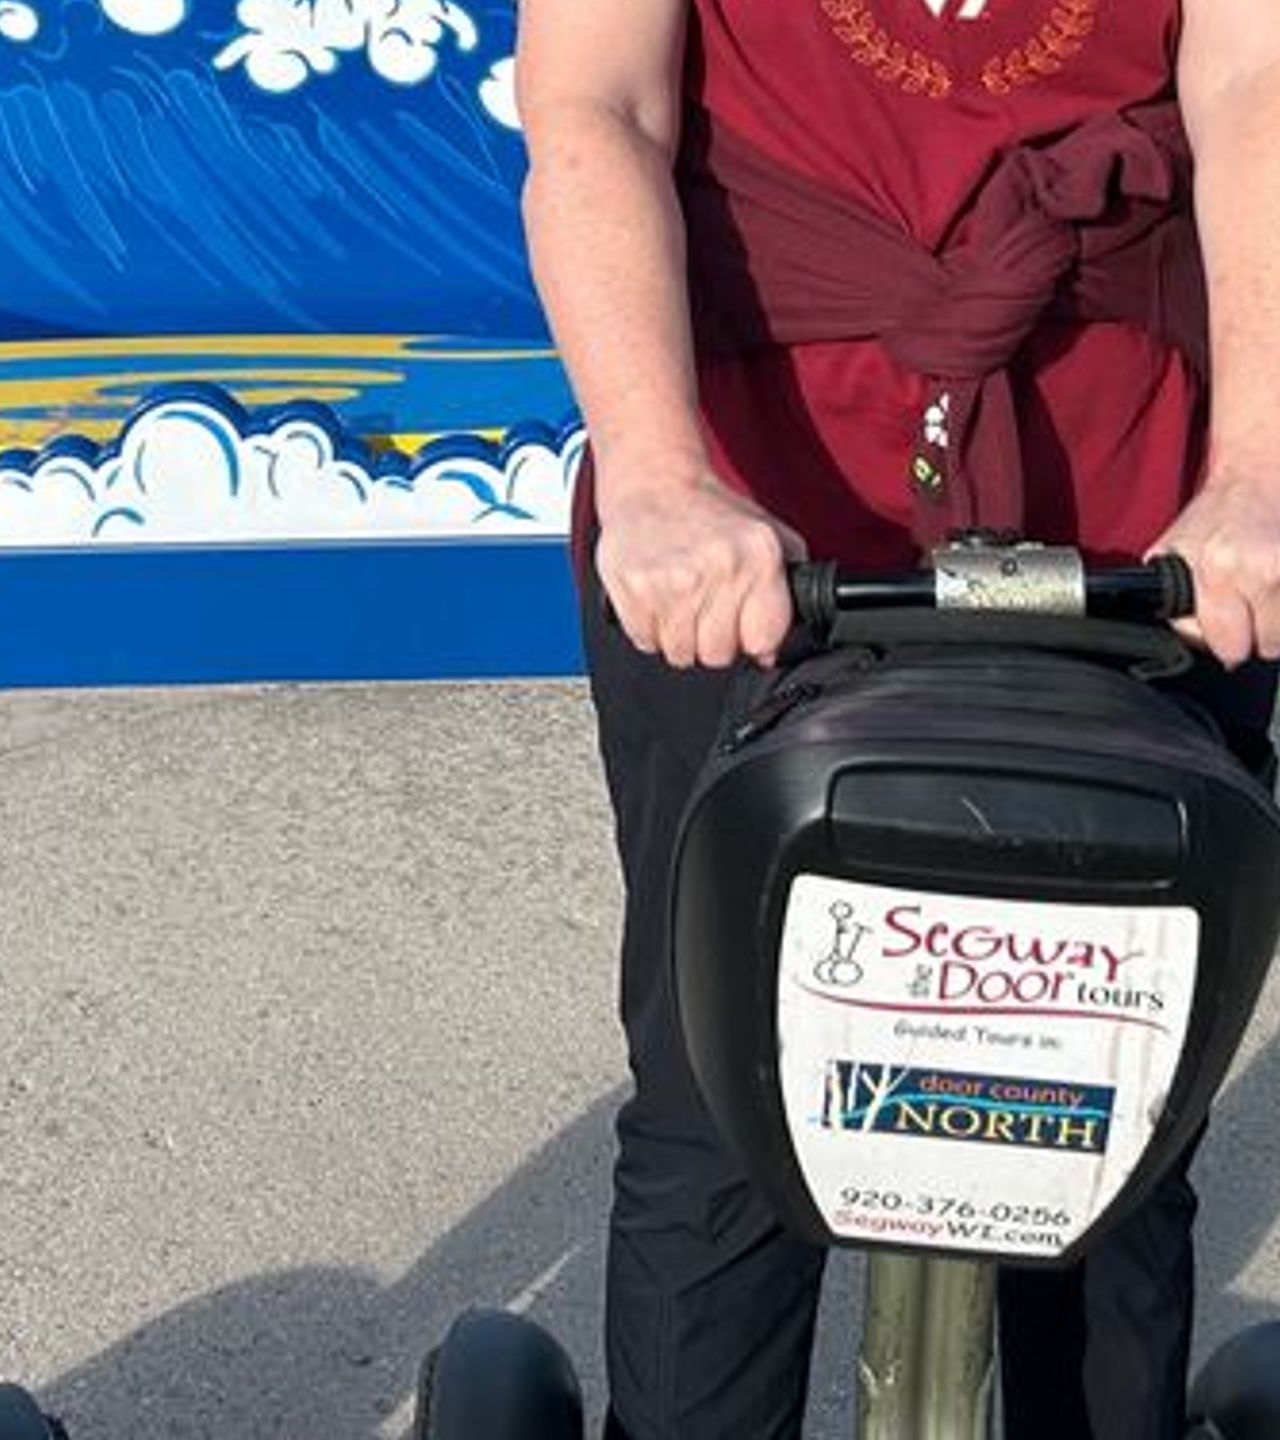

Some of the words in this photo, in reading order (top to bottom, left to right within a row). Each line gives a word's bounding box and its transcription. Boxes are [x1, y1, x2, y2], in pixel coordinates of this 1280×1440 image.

[1077, 981, 1165, 1012] tours
[920, 1074, 982, 1096] door
[989, 1082, 1085, 1108] county
[893, 1100, 1097, 1149] NORTH
[839, 1186, 1071, 1228] 920-376-0256
